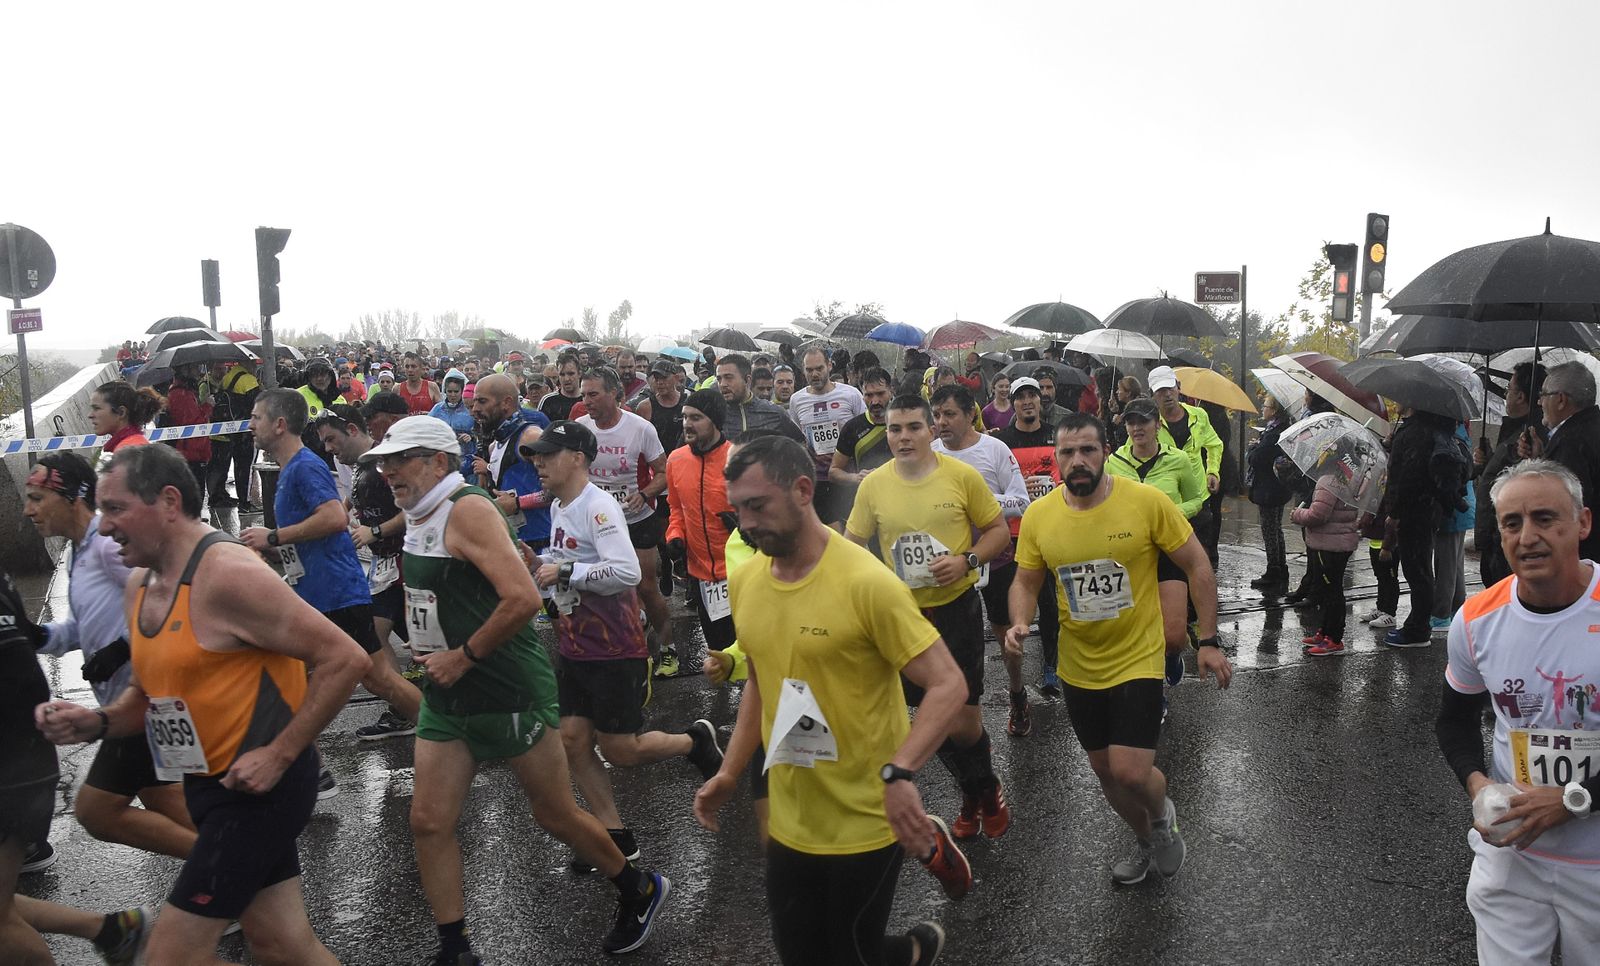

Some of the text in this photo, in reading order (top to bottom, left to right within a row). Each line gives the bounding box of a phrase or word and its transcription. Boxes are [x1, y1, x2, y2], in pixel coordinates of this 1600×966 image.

[814, 428, 838, 442] 6866
[903, 545, 948, 566] 693
[706, 584, 728, 604] 715
[1074, 572, 1124, 596] 7437
[812, 628, 830, 636] CIA
[1504, 678, 1525, 694] 32
[1534, 754, 1591, 786] 101
